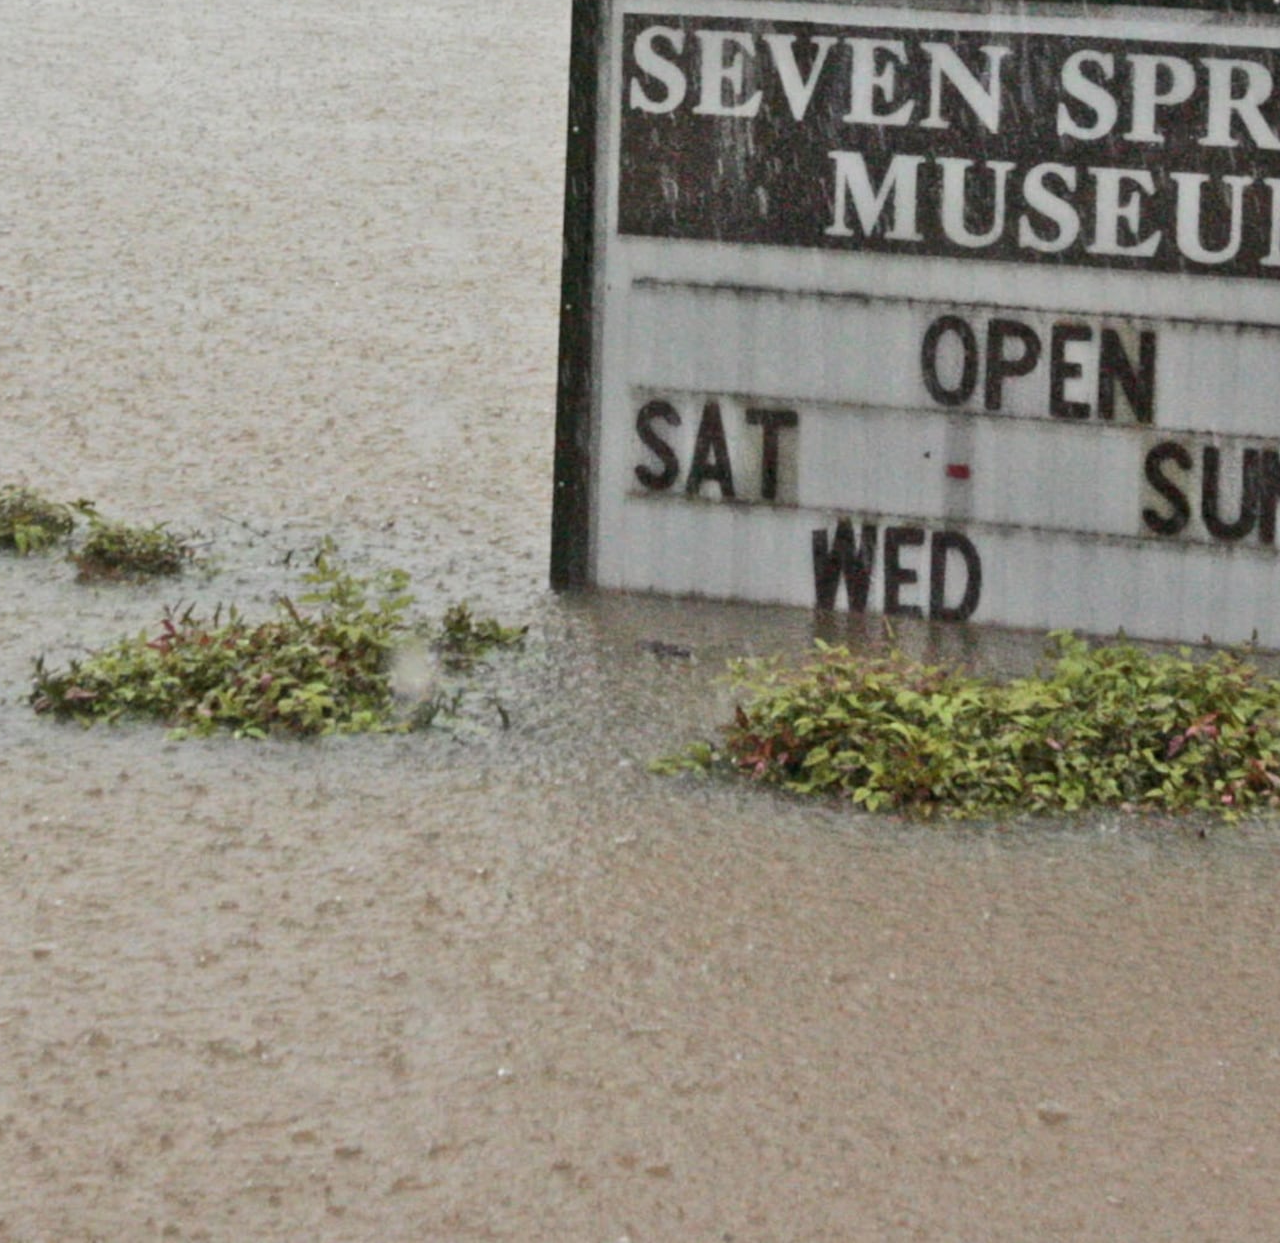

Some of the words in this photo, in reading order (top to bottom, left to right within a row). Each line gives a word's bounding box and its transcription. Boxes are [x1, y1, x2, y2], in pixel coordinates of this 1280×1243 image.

[629, 25, 1014, 135] SEVEN
[921, 314, 1157, 424] OPEN
[633, 399, 799, 500] SAT
[811, 516, 983, 622] WED
